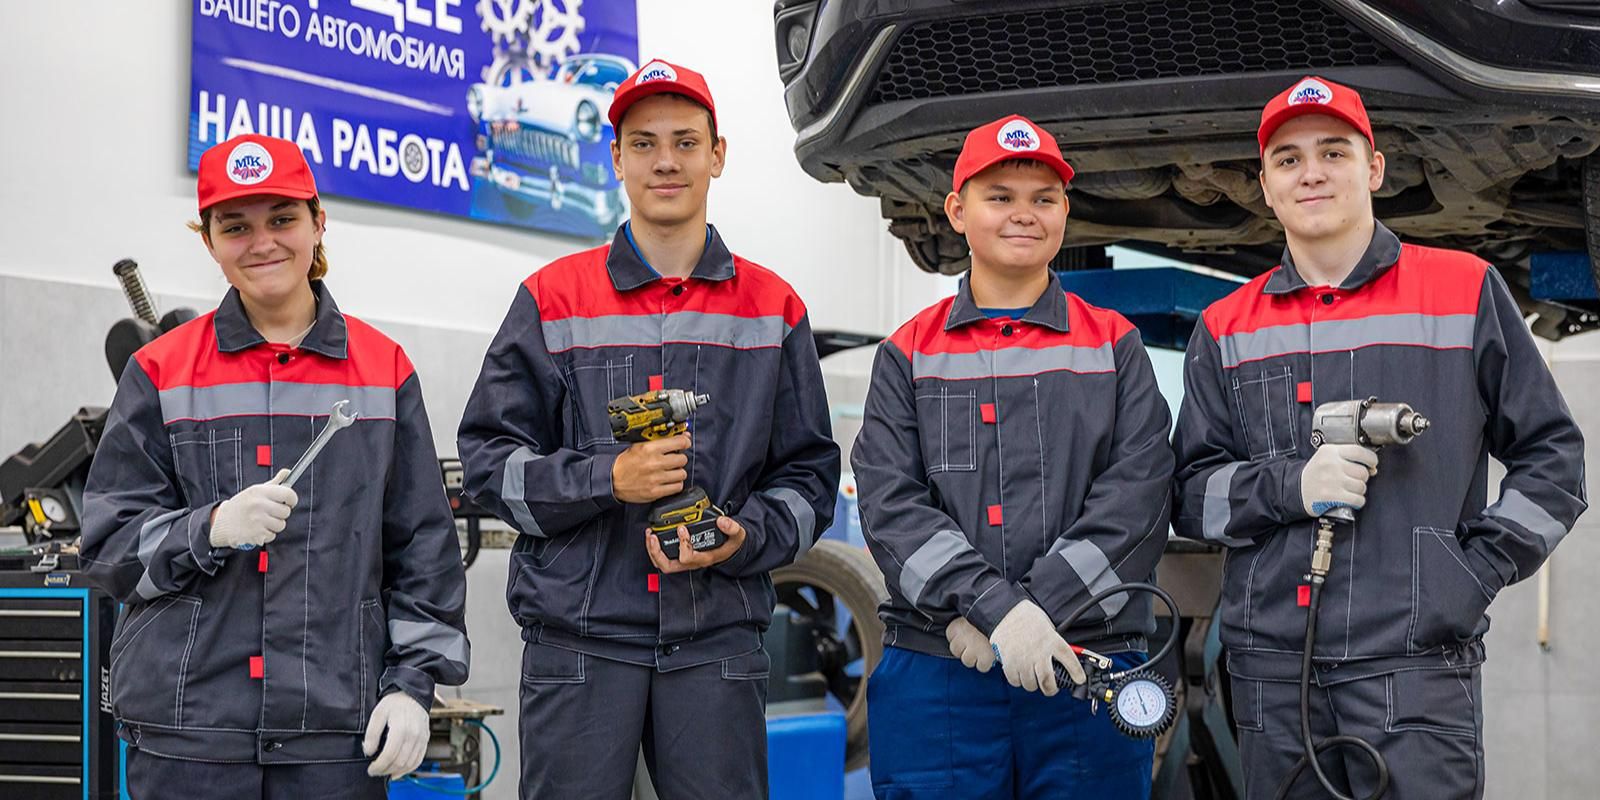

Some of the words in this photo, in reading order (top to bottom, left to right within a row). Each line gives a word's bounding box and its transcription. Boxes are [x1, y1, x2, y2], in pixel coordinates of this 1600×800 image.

[305, 12, 465, 80] АВТОМОБИЛЯ
[332, 118, 470, 191] РАБОТА
[100, 665, 112, 713] HAZET
